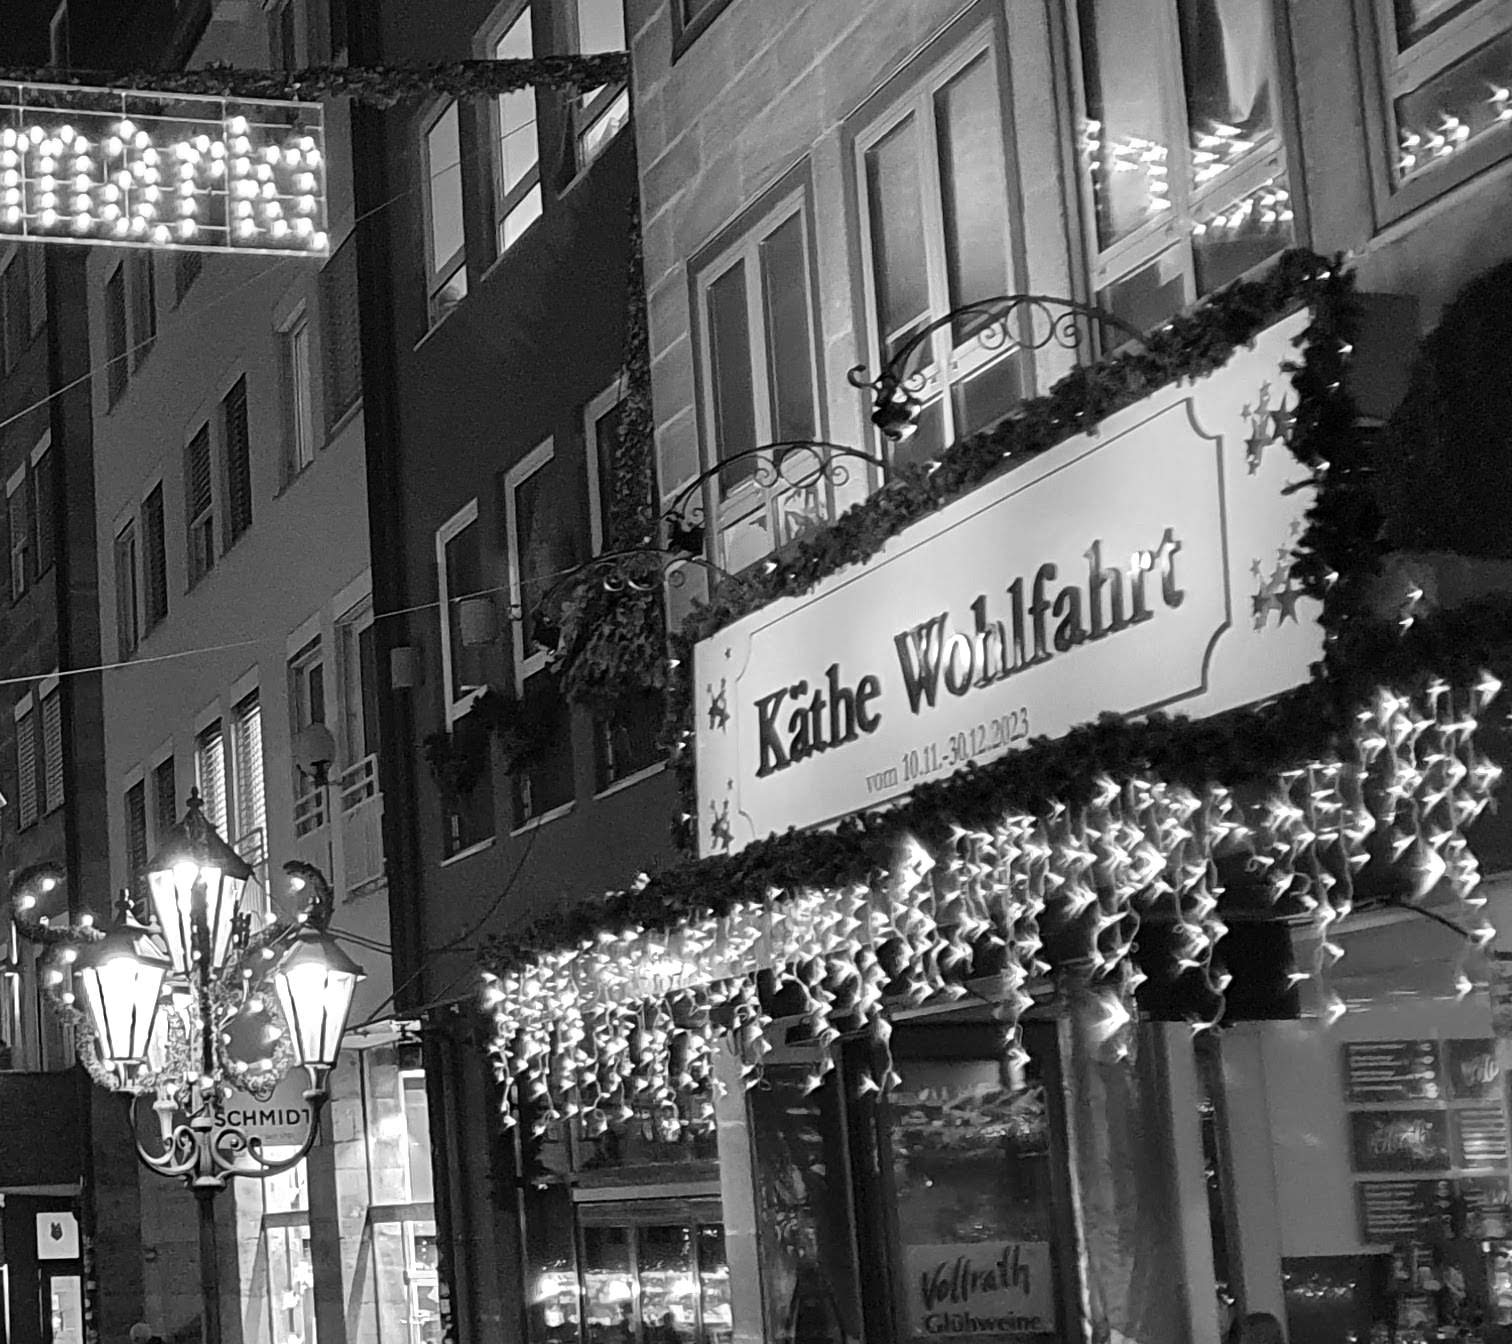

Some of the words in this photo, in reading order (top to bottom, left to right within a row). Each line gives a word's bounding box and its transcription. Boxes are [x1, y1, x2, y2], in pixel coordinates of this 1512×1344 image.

[755, 662, 882, 779] Käthe
[894, 528, 1185, 714] Wohlfahrt
[865, 767, 899, 793] vom
[921, 1244, 1031, 1311] Vollrath
[925, 1311, 1042, 1334] Glühweine
